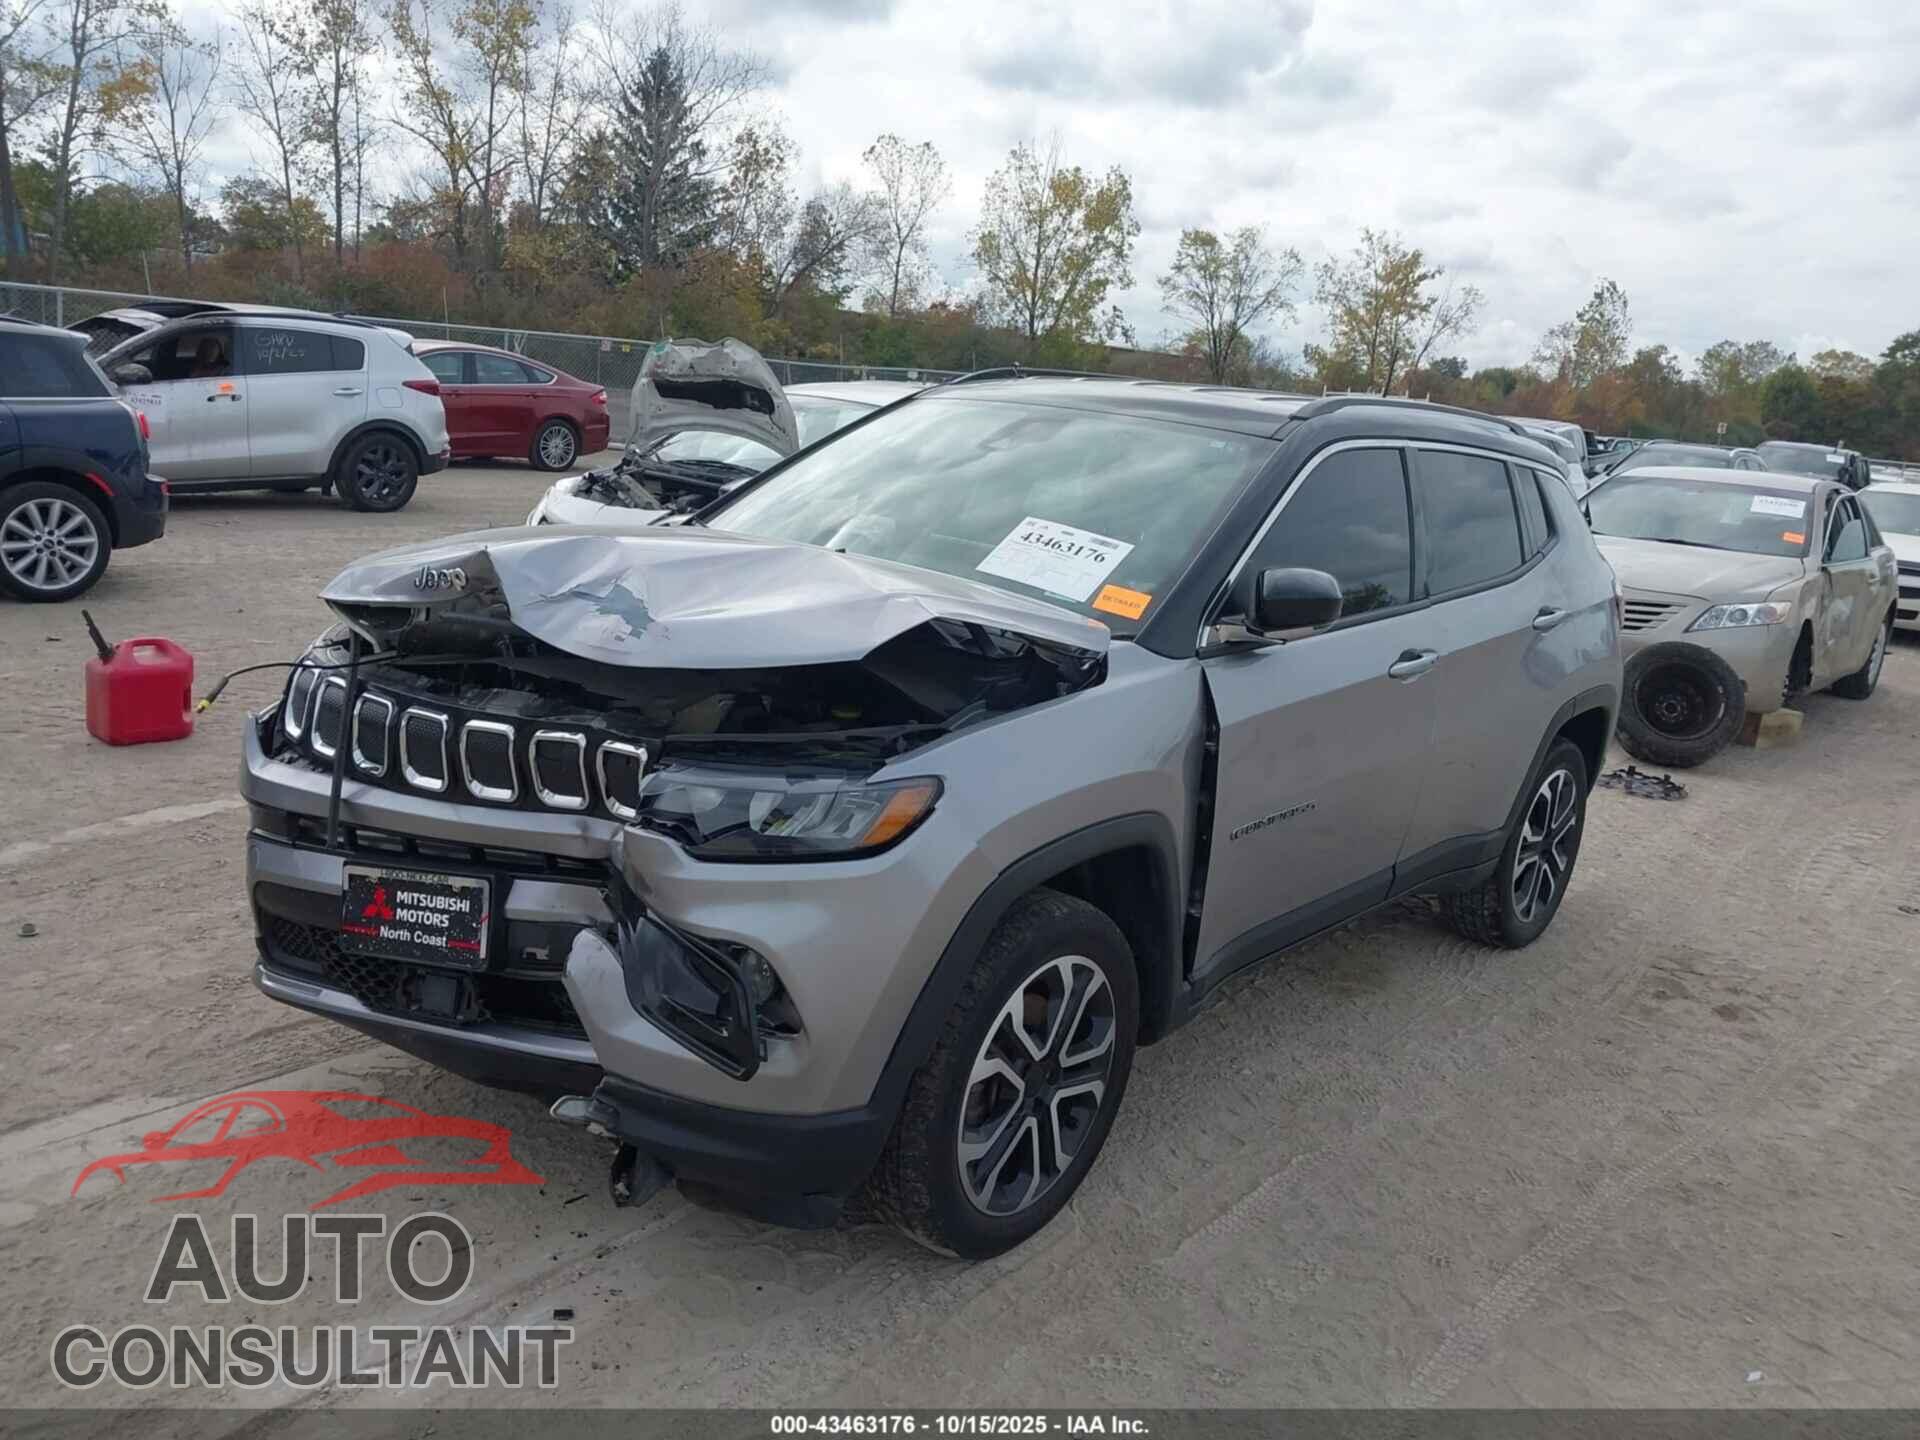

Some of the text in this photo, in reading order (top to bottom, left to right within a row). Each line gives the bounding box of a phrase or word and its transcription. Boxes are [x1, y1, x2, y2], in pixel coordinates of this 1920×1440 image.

[1020, 531, 1106, 563] 43463176
[414, 564, 467, 591] Jeep
[396, 891, 470, 913] MITSUBISHI
[396, 908, 450, 928] MOTORS
[379, 925, 447, 948] North Coast
